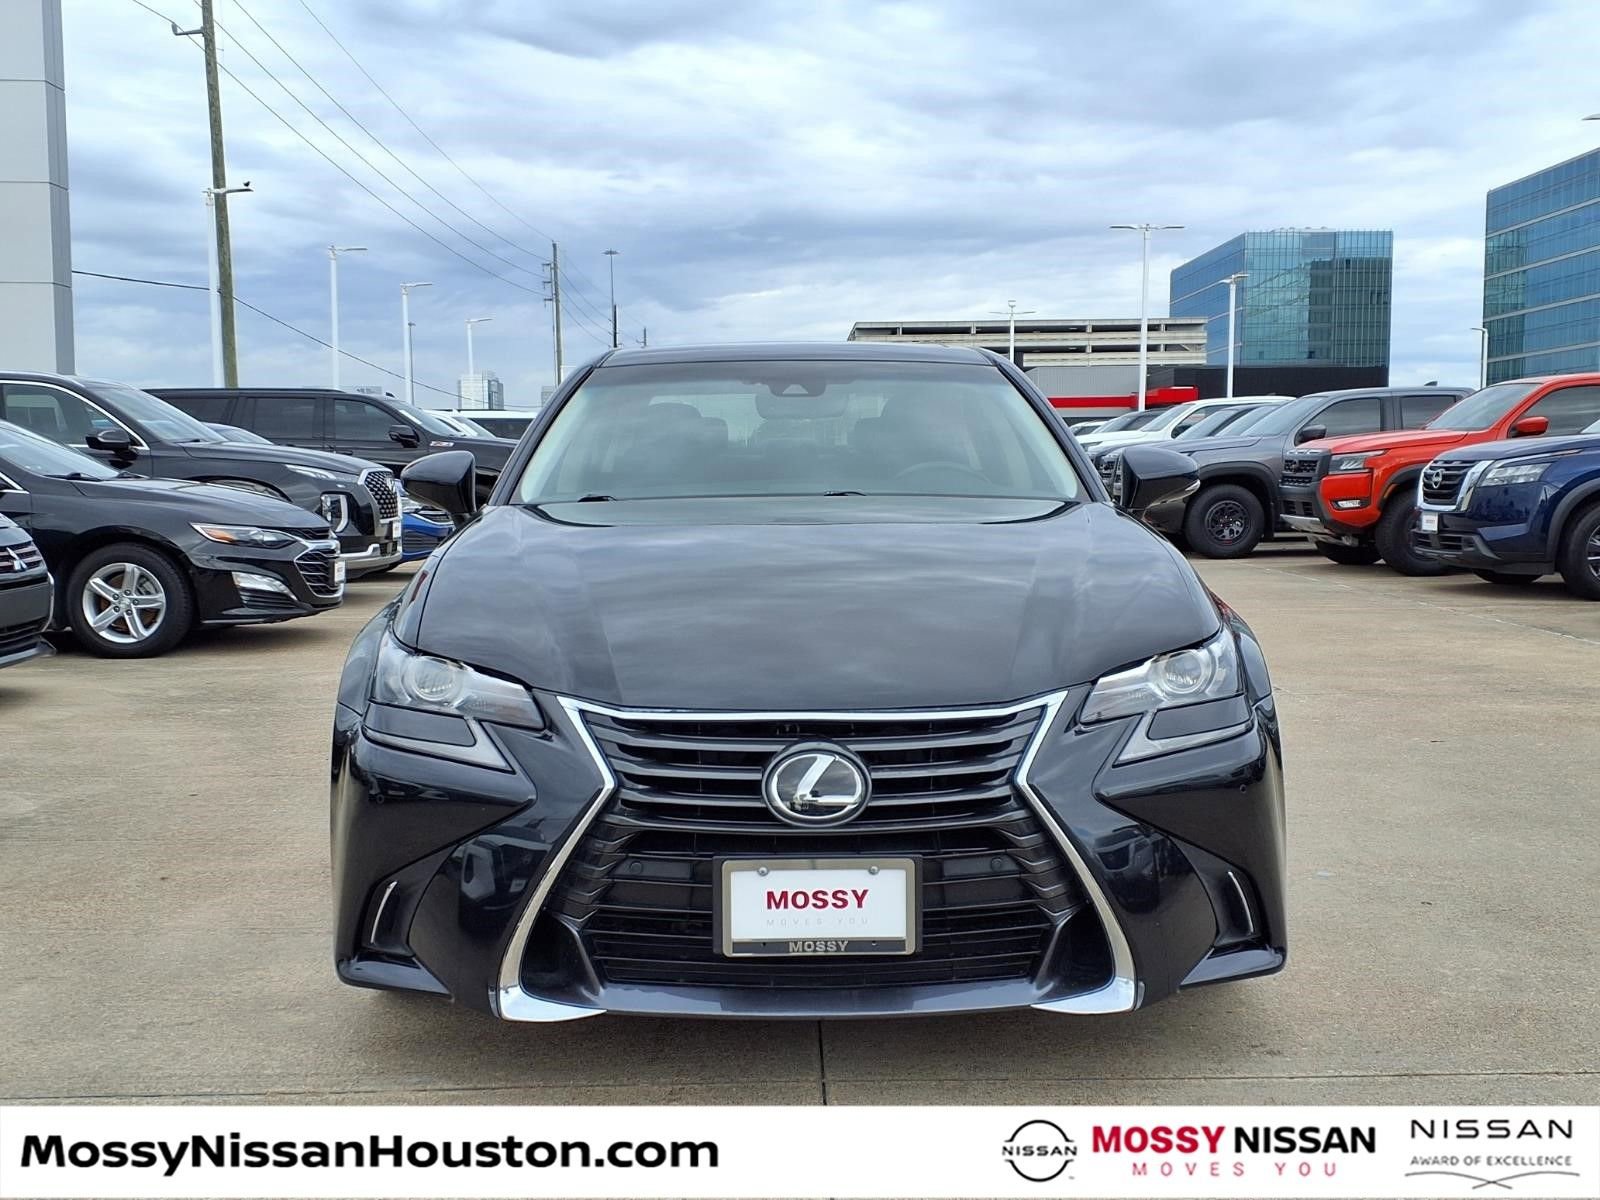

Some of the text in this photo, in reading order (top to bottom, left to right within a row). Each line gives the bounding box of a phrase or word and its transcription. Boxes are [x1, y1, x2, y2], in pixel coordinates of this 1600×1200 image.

[766, 889, 869, 910] MOSSY
[766, 916, 870, 926] MOVES YOU
[788, 940, 849, 953] MOSSY
